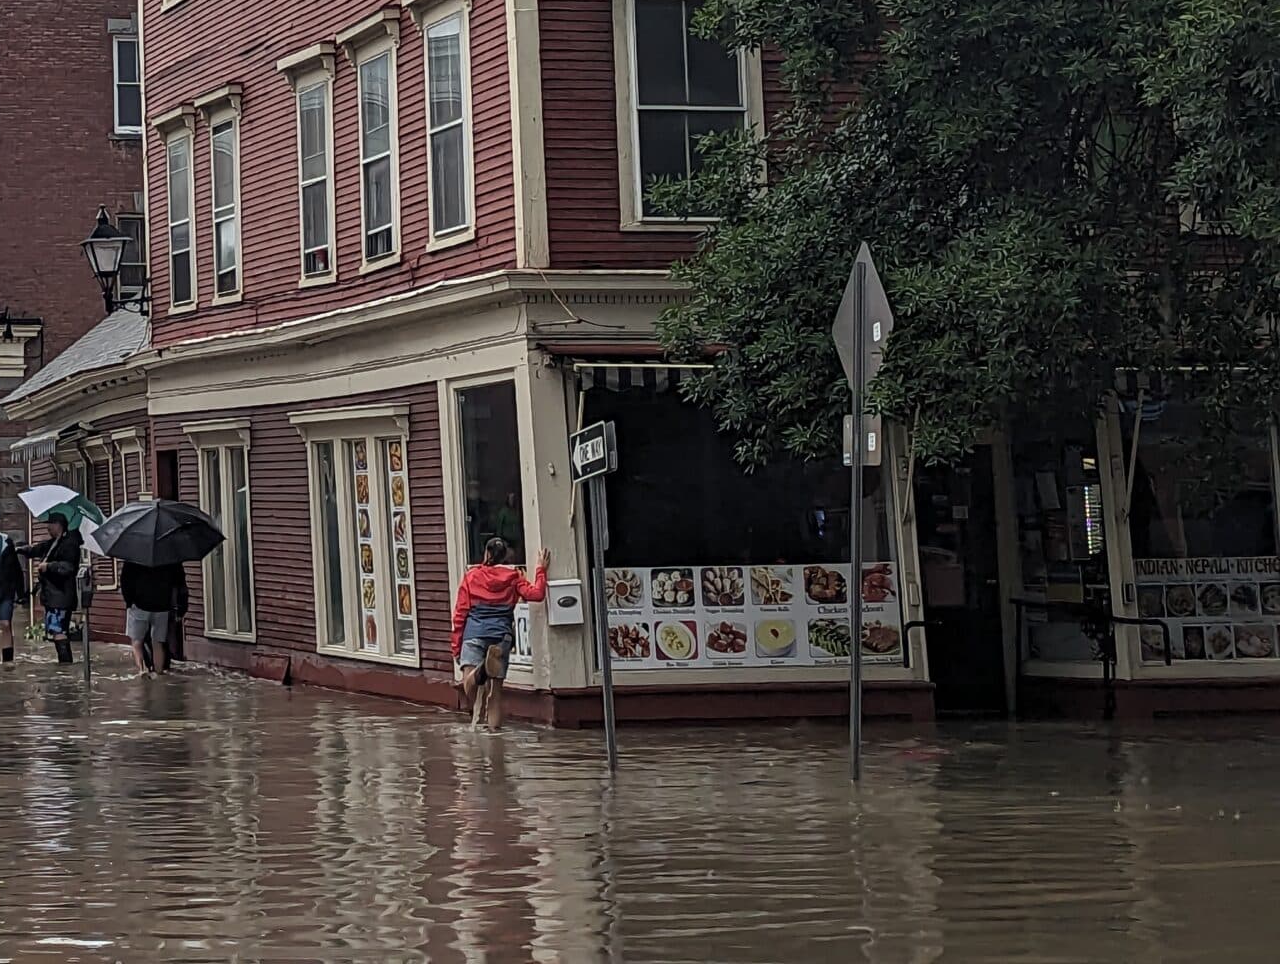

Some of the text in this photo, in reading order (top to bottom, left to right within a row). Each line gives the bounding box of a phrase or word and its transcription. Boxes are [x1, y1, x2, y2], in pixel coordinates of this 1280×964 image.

[590, 438, 602, 459] WAY
[1135, 560, 1178, 576] INDIAN
[1185, 558, 1230, 574] NEPALI
